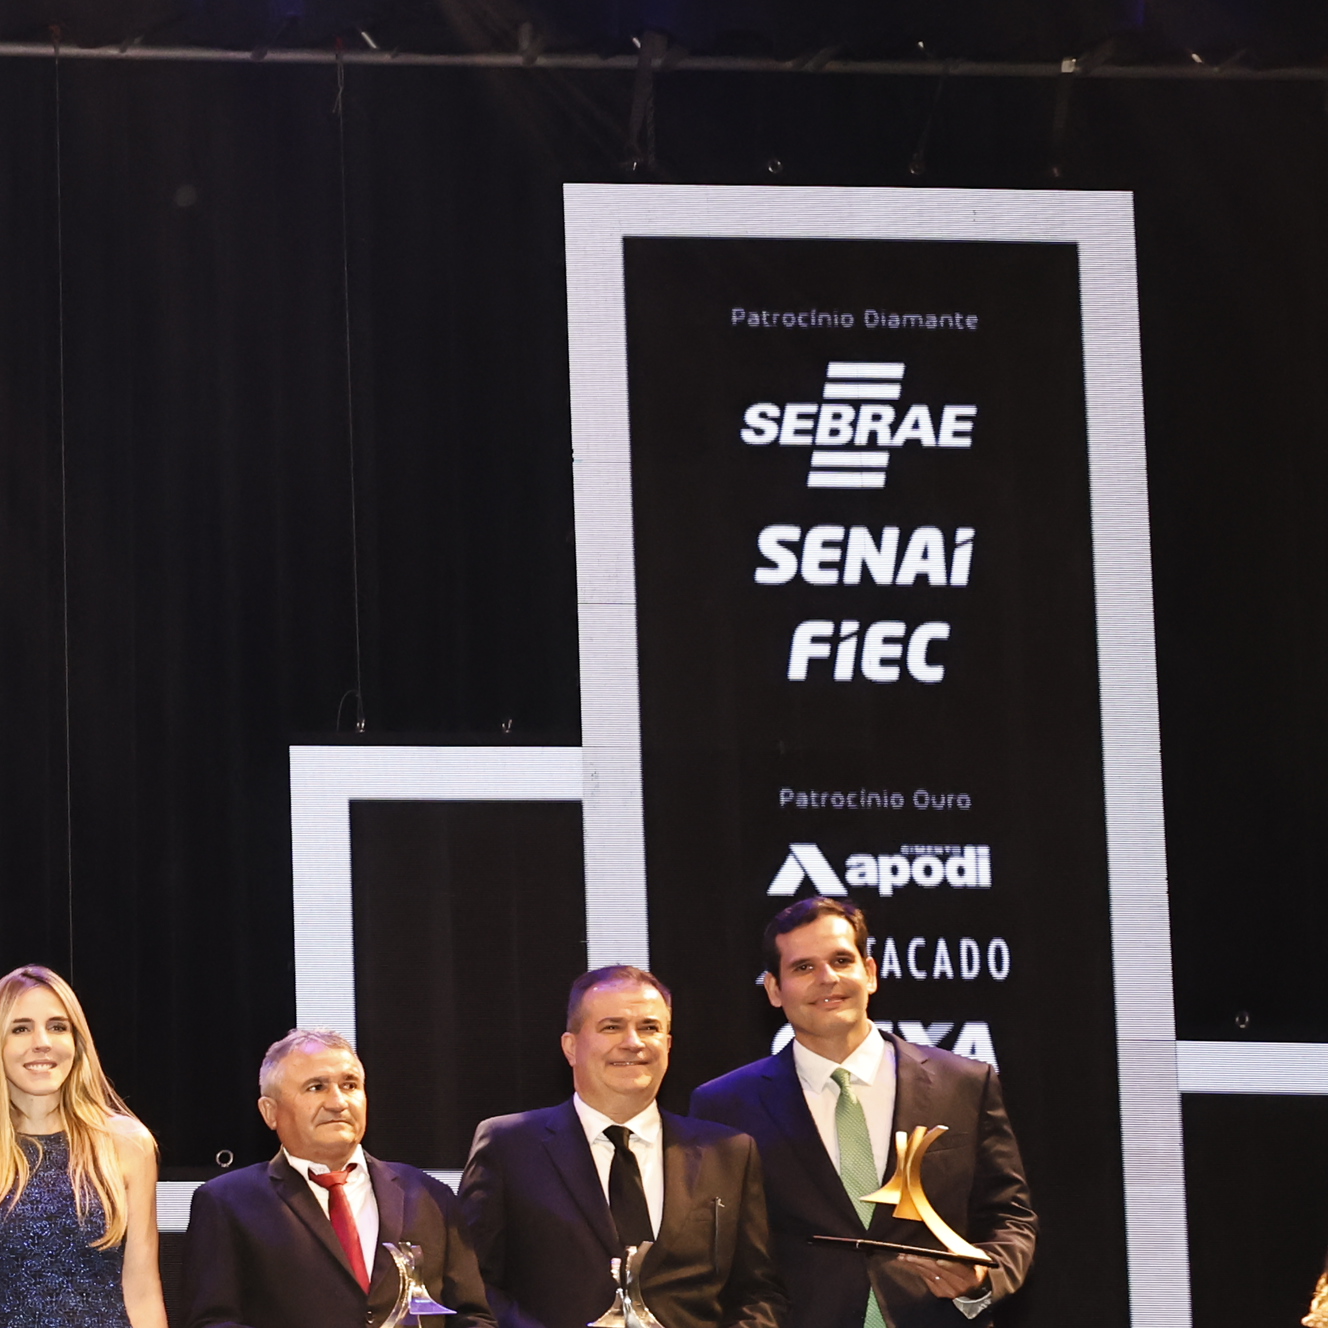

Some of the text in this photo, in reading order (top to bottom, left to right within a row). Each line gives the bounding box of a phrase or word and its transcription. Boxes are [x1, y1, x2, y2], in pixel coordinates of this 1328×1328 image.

[731, 308, 979, 330] Patrocínio Diamante
[740, 402, 979, 449] SEBRAE
[912, 789, 972, 811] Ouro
[845, 845, 992, 897] apodi
